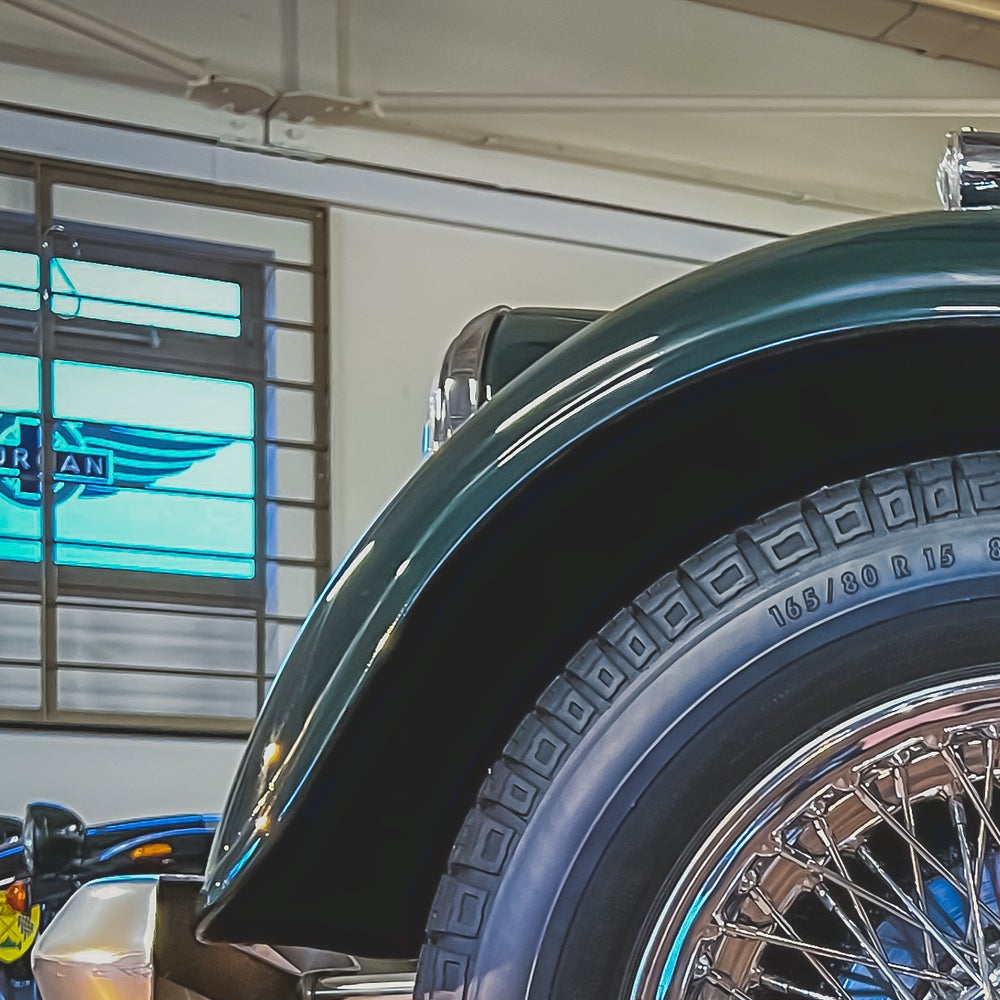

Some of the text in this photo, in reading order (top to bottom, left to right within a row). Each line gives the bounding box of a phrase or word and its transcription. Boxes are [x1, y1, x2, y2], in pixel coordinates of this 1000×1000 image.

[0, 447, 104, 475] RAN
[768, 562, 880, 629] 165/80
[890, 555, 912, 579] R
[922, 542, 956, 571] 15
